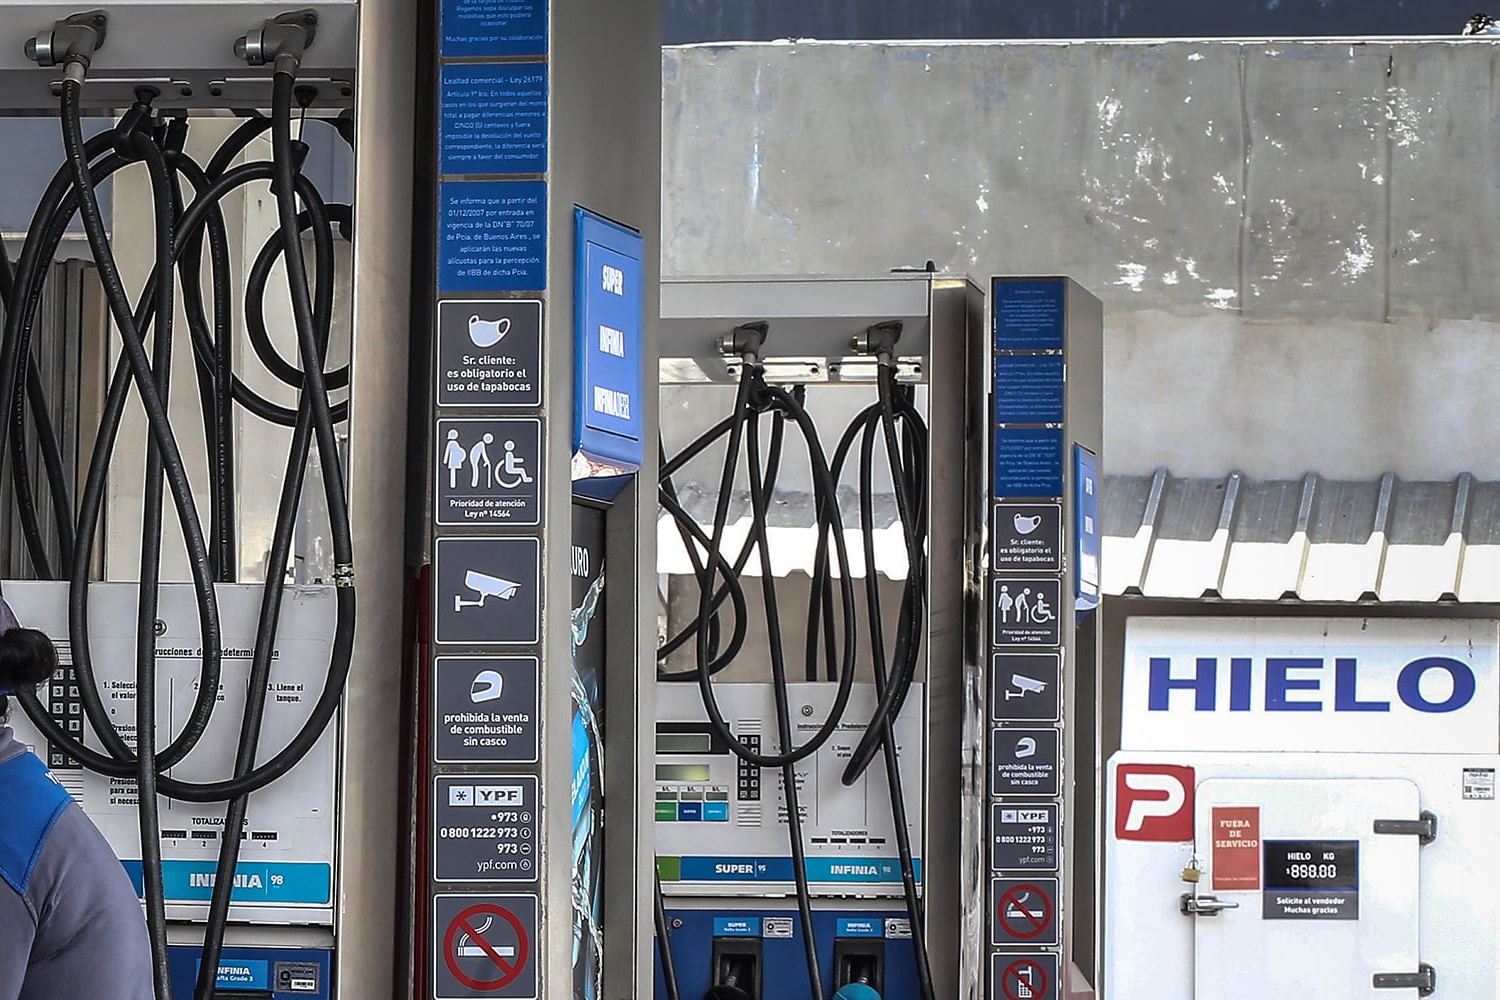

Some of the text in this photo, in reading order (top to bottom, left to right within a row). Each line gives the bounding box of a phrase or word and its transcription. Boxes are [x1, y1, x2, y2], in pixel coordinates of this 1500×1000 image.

[602, 264, 624, 296] SUPER
[600, 325, 625, 358] INFINIA
[462, 355, 516, 365] Sr. cliente:
[447, 368, 526, 380] es obligatorio el
[447, 382, 531, 393] uso de tapabocas
[450, 500, 526, 508] Prioridad de atención
[465, 510, 511, 519] Ley 14564
[570, 545, 589, 578] URO
[1148, 657, 1476, 713] HIELO
[444, 713, 529, 724] prohibida la venta
[450, 725, 523, 735] de combustible
[463, 737, 478, 746] sin
[480, 790, 518, 801] YPF
[1220, 820, 1251, 828] FUERA
[1229, 830, 1242, 838] DE
[497, 843, 518, 854] 973
[1215, 840, 1258, 848] SERVICIO
[1019, 856, 1046, 864] ypf.com
[1287, 852, 1335, 860] HIELO KG
[477, 859, 517, 872] ypf.com
[715, 864, 754, 874] SUPER
[830, 865, 878, 875] INFINIA
[189, 873, 284, 888] INFNIA 98
[1276, 897, 1345, 905] Solicite al vendedor
[1284, 906, 1338, 915] Muchas gracias
[217, 967, 250, 976] NFINIA
